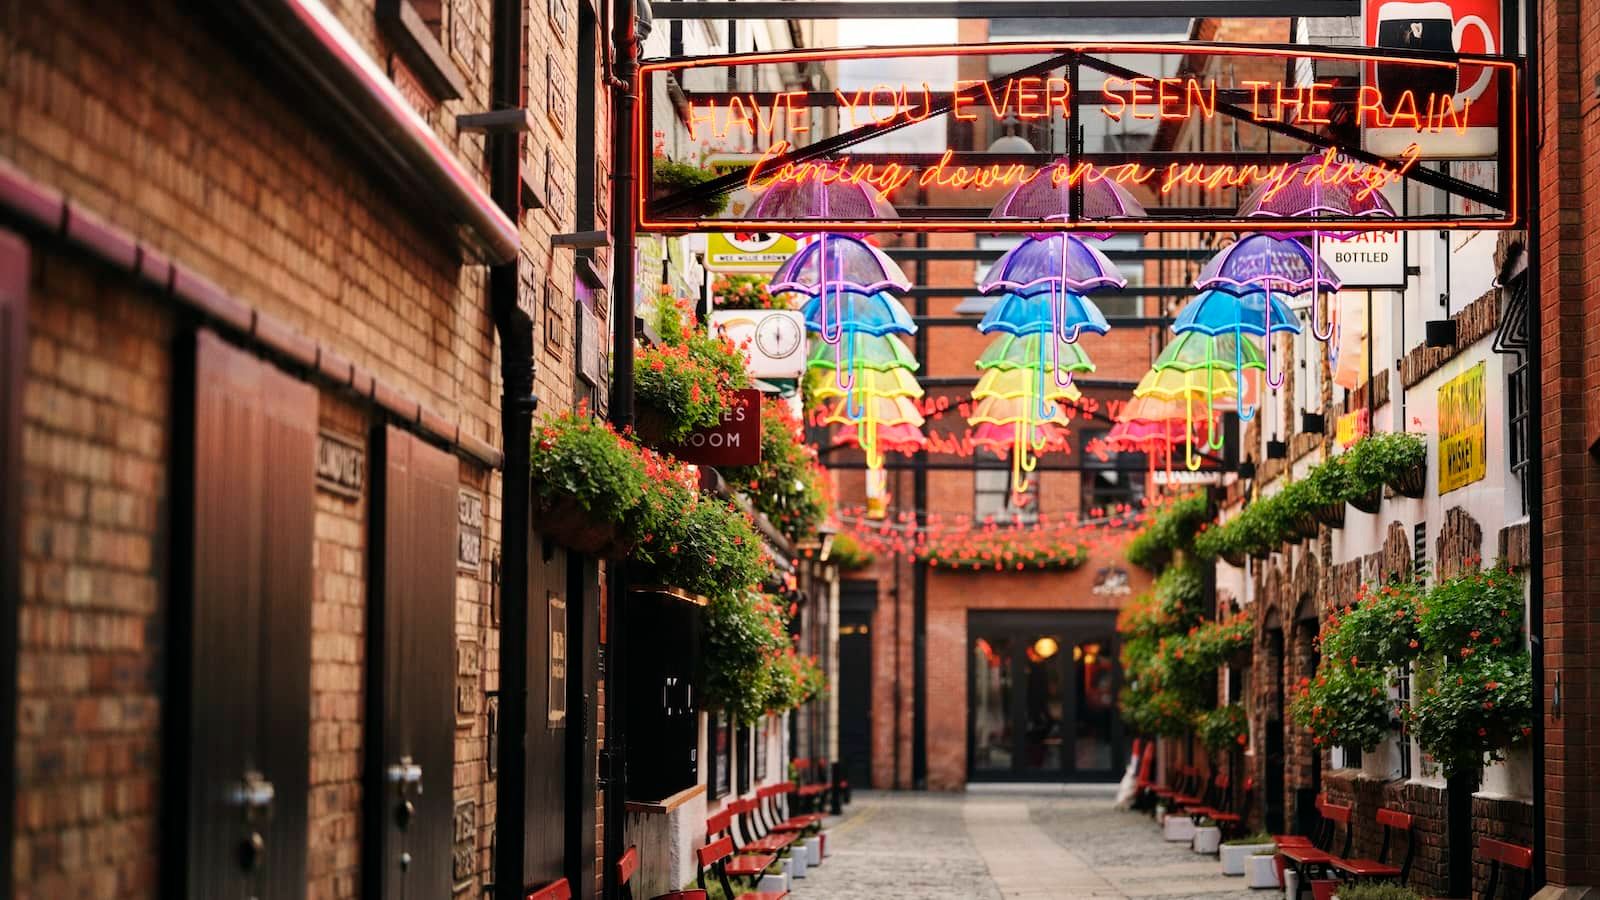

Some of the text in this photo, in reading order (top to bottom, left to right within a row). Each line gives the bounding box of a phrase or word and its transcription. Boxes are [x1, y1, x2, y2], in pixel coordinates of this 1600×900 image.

[687, 77, 1471, 141] HAVE YOU EVER SEEN THE RAIN
[745, 140, 913, 202] Coming
[919, 149, 1041, 191] down
[1051, 160, 1105, 188] on
[1115, 163, 1156, 185] a
[1161, 161, 1300, 202] sunny
[1303, 143, 1423, 202] day?
[1335, 252, 1389, 263] BOTTLED
[1447, 435, 1473, 476] WHISKEY
